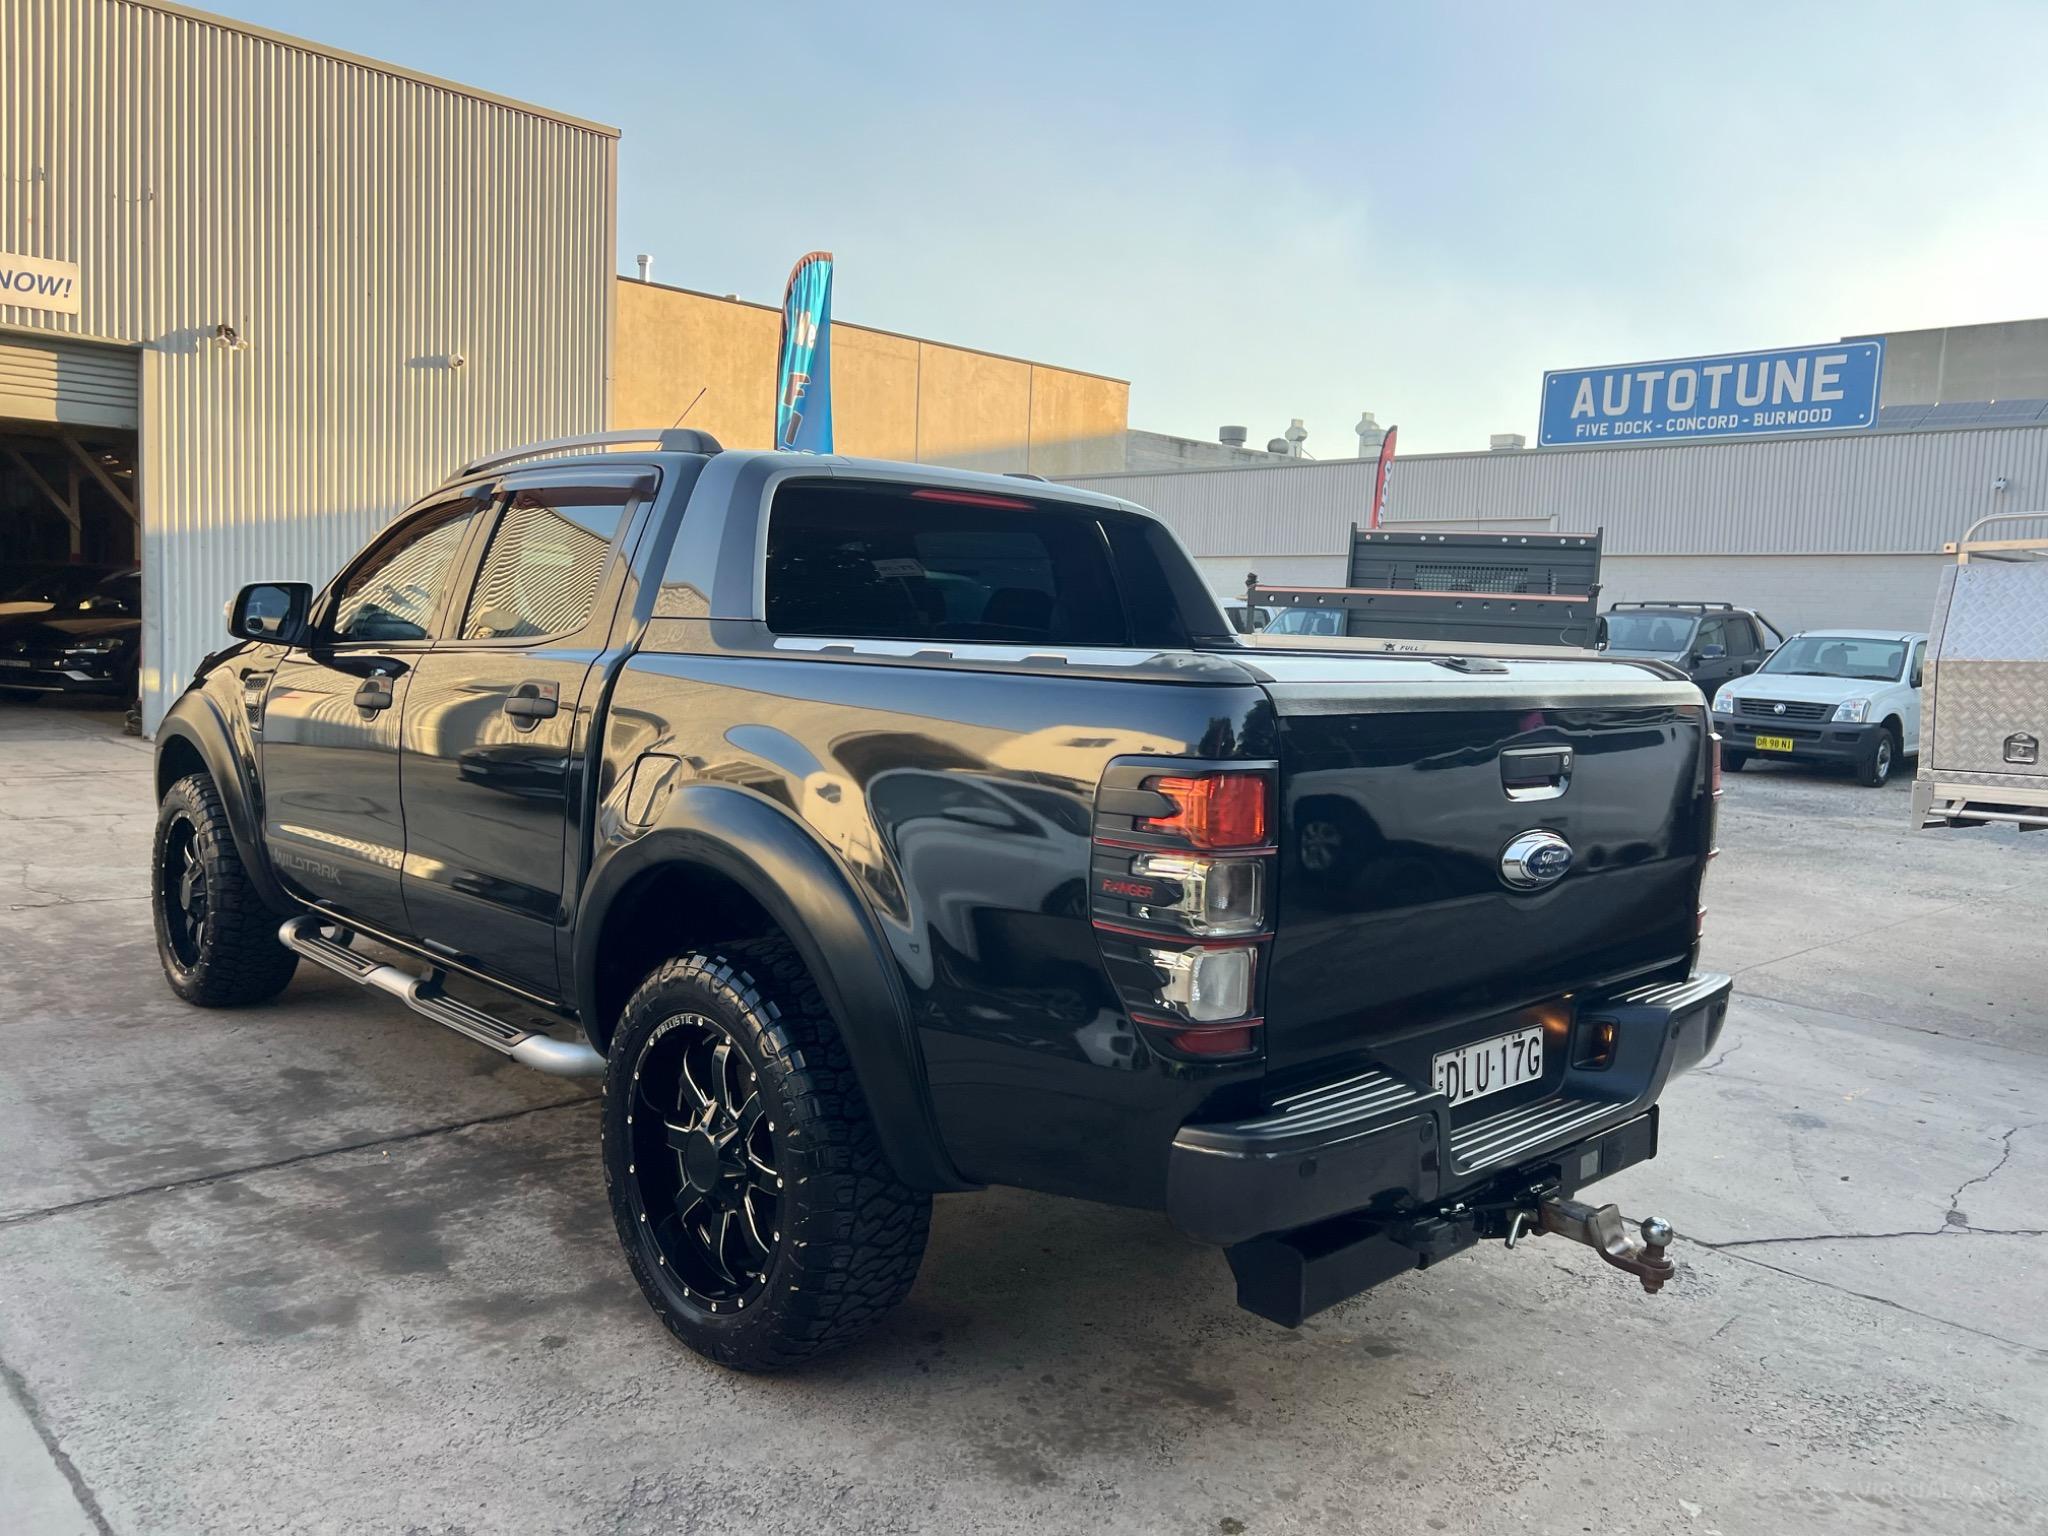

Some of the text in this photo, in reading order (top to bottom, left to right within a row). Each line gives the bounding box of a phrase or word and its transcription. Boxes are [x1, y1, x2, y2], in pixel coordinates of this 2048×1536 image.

[0, 269, 72, 298] NOW!
[1570, 353, 1848, 419] AUTOTUNE
[1576, 422, 1608, 438] FIVE
[1614, 419, 1652, 435] DOCK
[1666, 414, 1738, 432] CONCORD
[1753, 407, 1832, 426] BURWOOD
